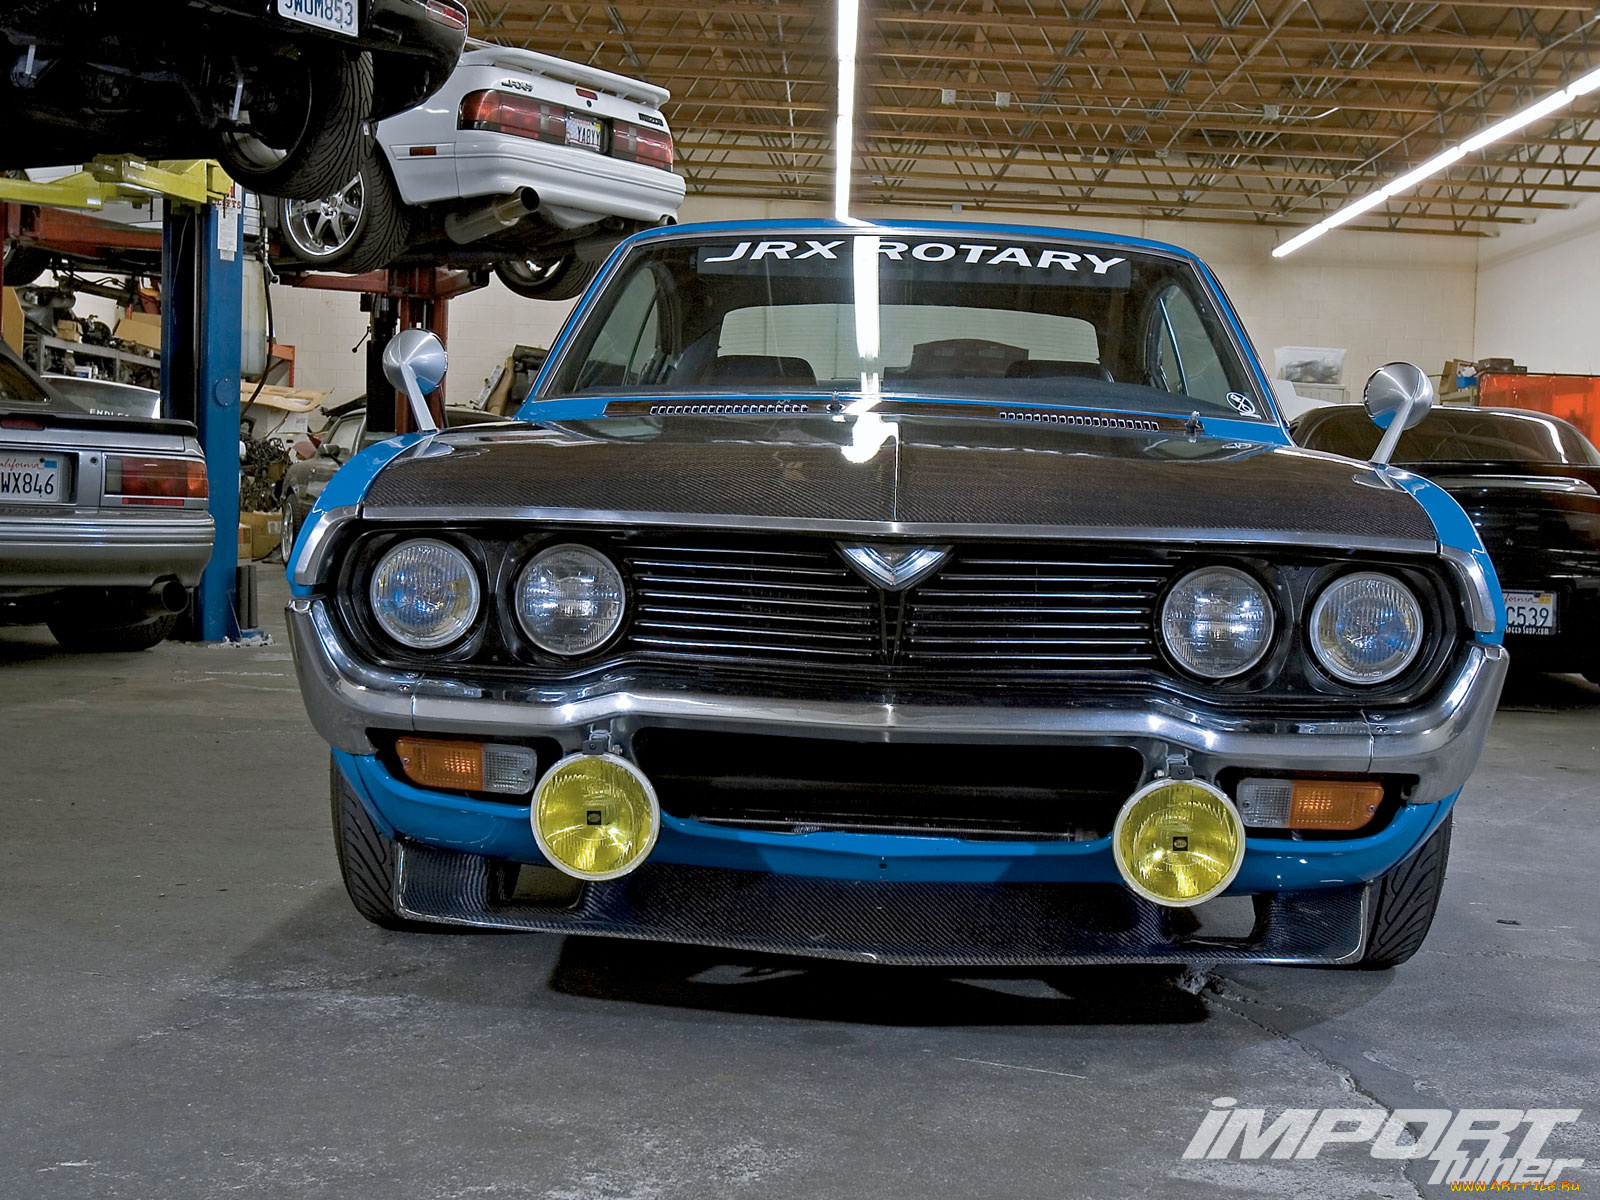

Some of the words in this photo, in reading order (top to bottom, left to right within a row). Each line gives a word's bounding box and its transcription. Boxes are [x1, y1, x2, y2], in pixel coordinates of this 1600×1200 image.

[216, 199, 242, 209] LFTS
[704, 240, 846, 263] JRX
[877, 241, 1127, 275] ROTARY
[1, 472, 55, 495] WX846
[1506, 606, 1549, 627] C539
